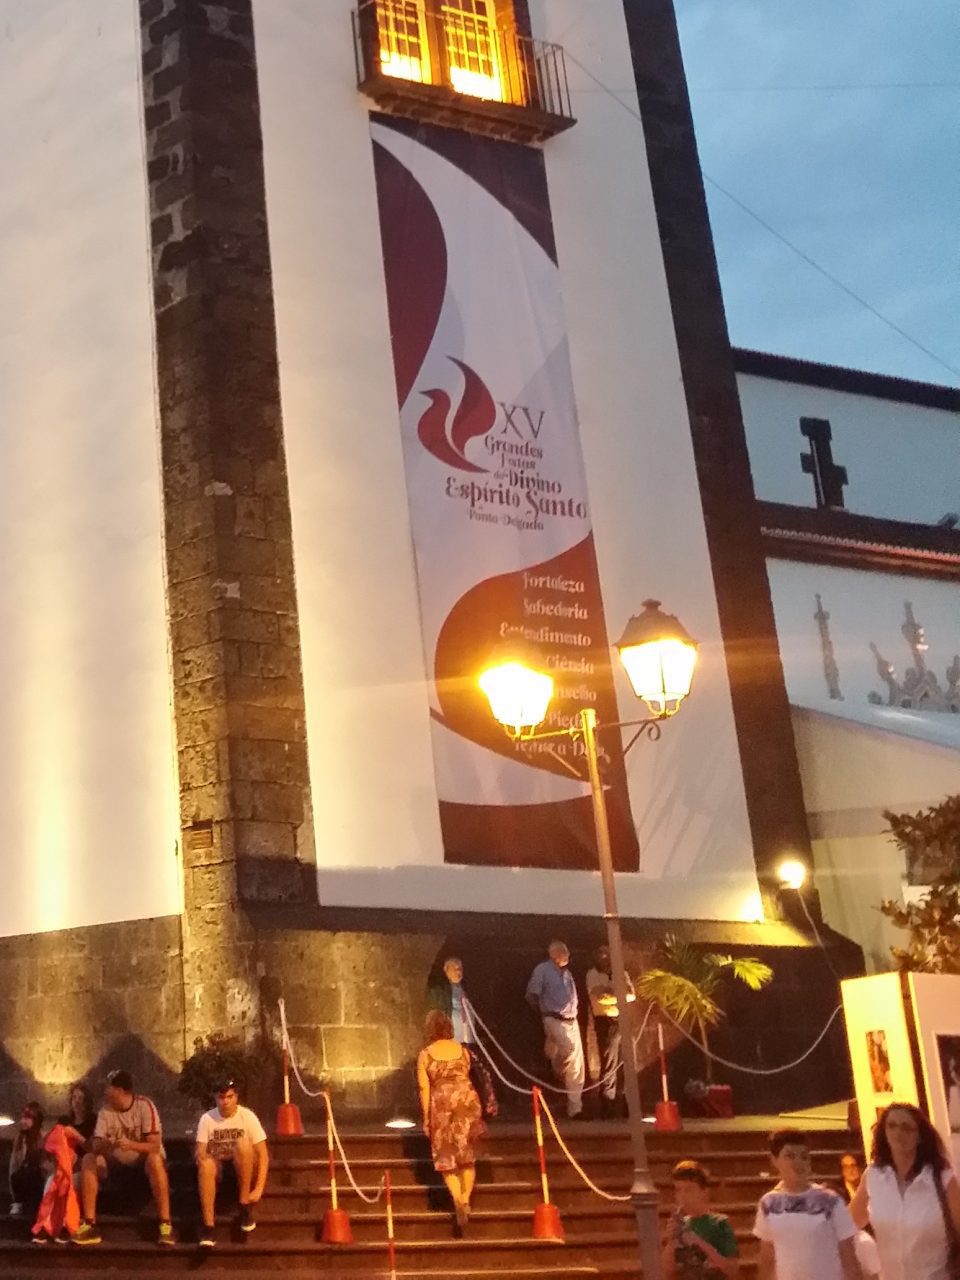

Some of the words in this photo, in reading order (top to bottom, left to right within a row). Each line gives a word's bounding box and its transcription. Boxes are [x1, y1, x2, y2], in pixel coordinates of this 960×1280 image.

[498, 402, 545, 439] XV
[484, 435, 543, 459] Grandes
[507, 470, 561, 493] Divino
[445, 476, 520, 508] Espírito
[525, 490, 587, 520] Santo
[522, 572, 585, 593] Fortaleza
[523, 598, 589, 620] Sabedoria
